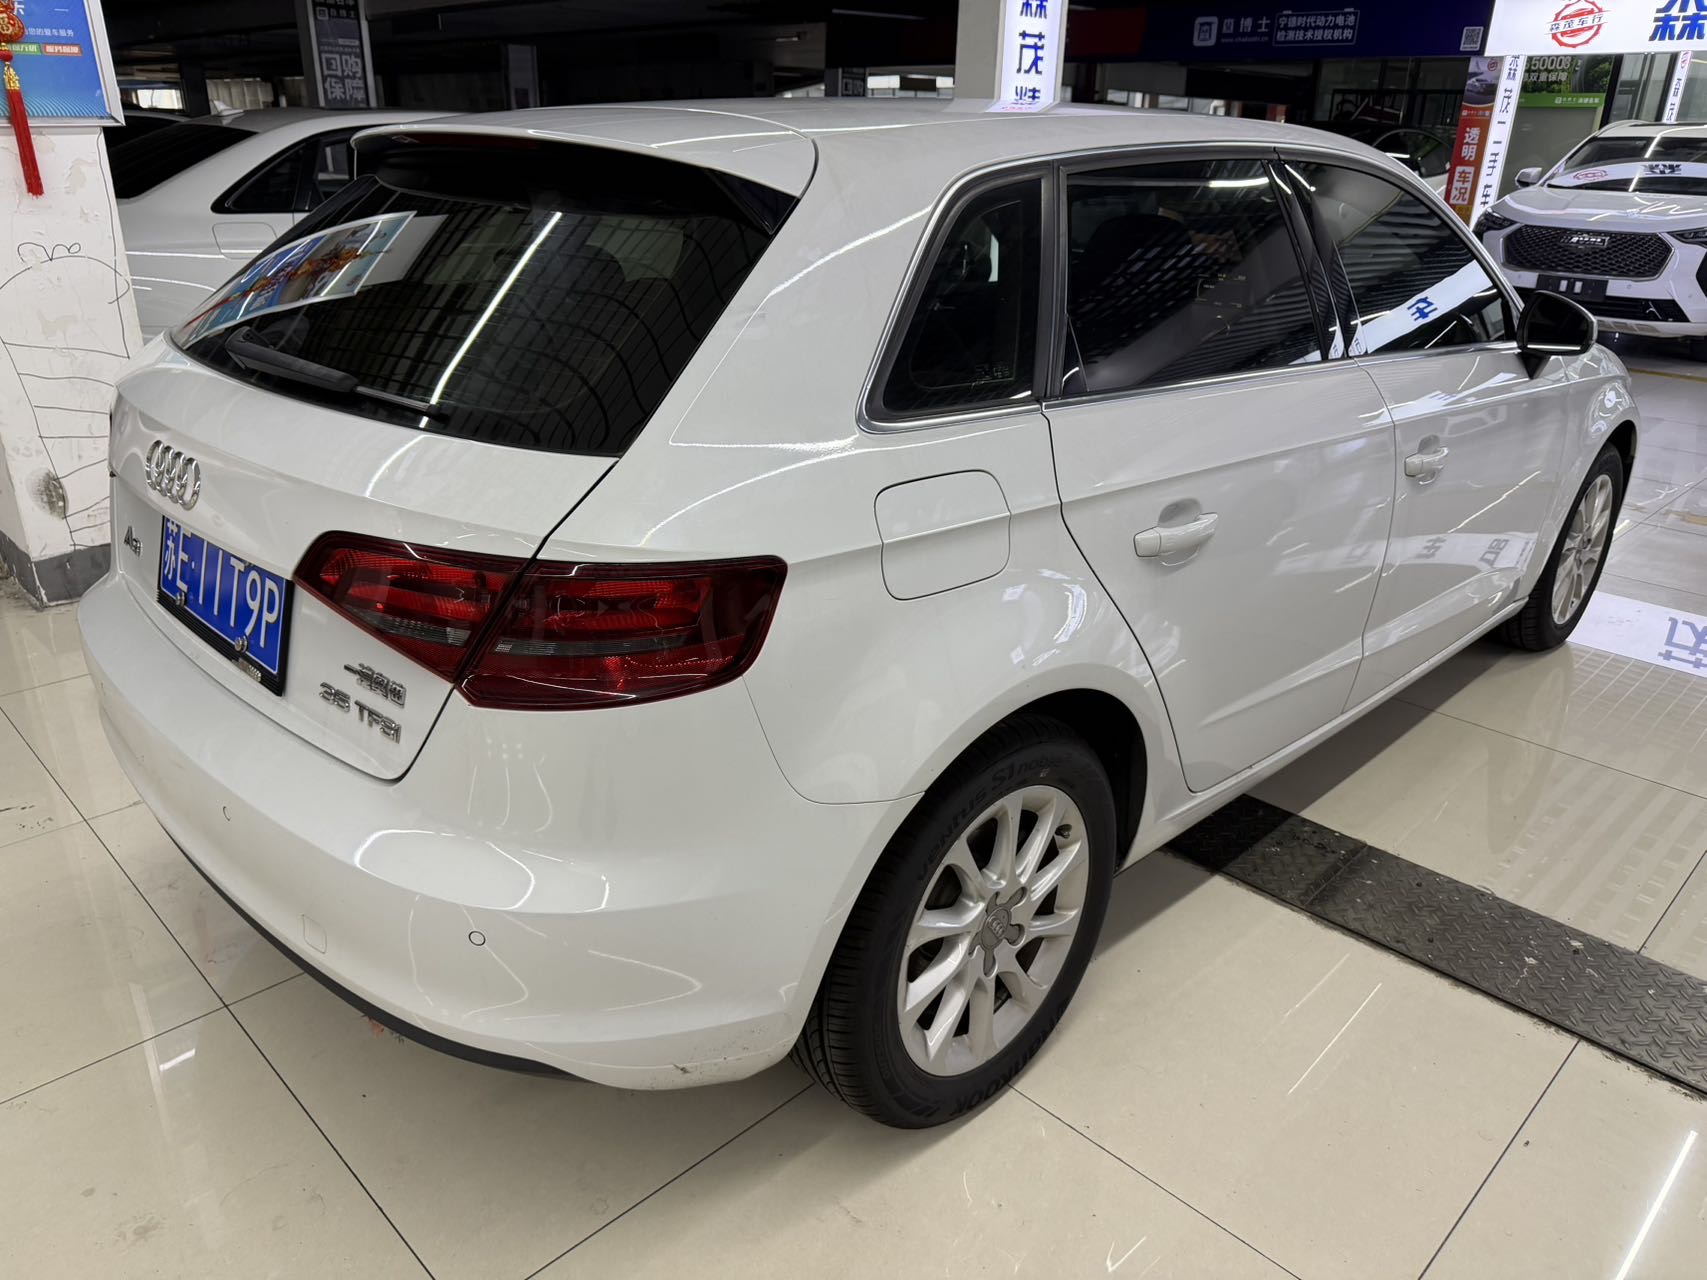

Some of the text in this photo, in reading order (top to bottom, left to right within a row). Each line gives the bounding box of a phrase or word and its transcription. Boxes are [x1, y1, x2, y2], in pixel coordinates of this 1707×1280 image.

[1278, 14, 1356, 28] 宁德时代动力电池
[1549, 14, 1604, 32] 森茂车行
[1276, 28, 1353, 41] 检测技术授权机构
[321, 53, 362, 78] 回购
[324, 77, 366, 100] 保障
[1461, 127, 1480, 161] 透明
[1452, 169, 1472, 202] 车况
[319, 681, 402, 744] 35 TFSI
